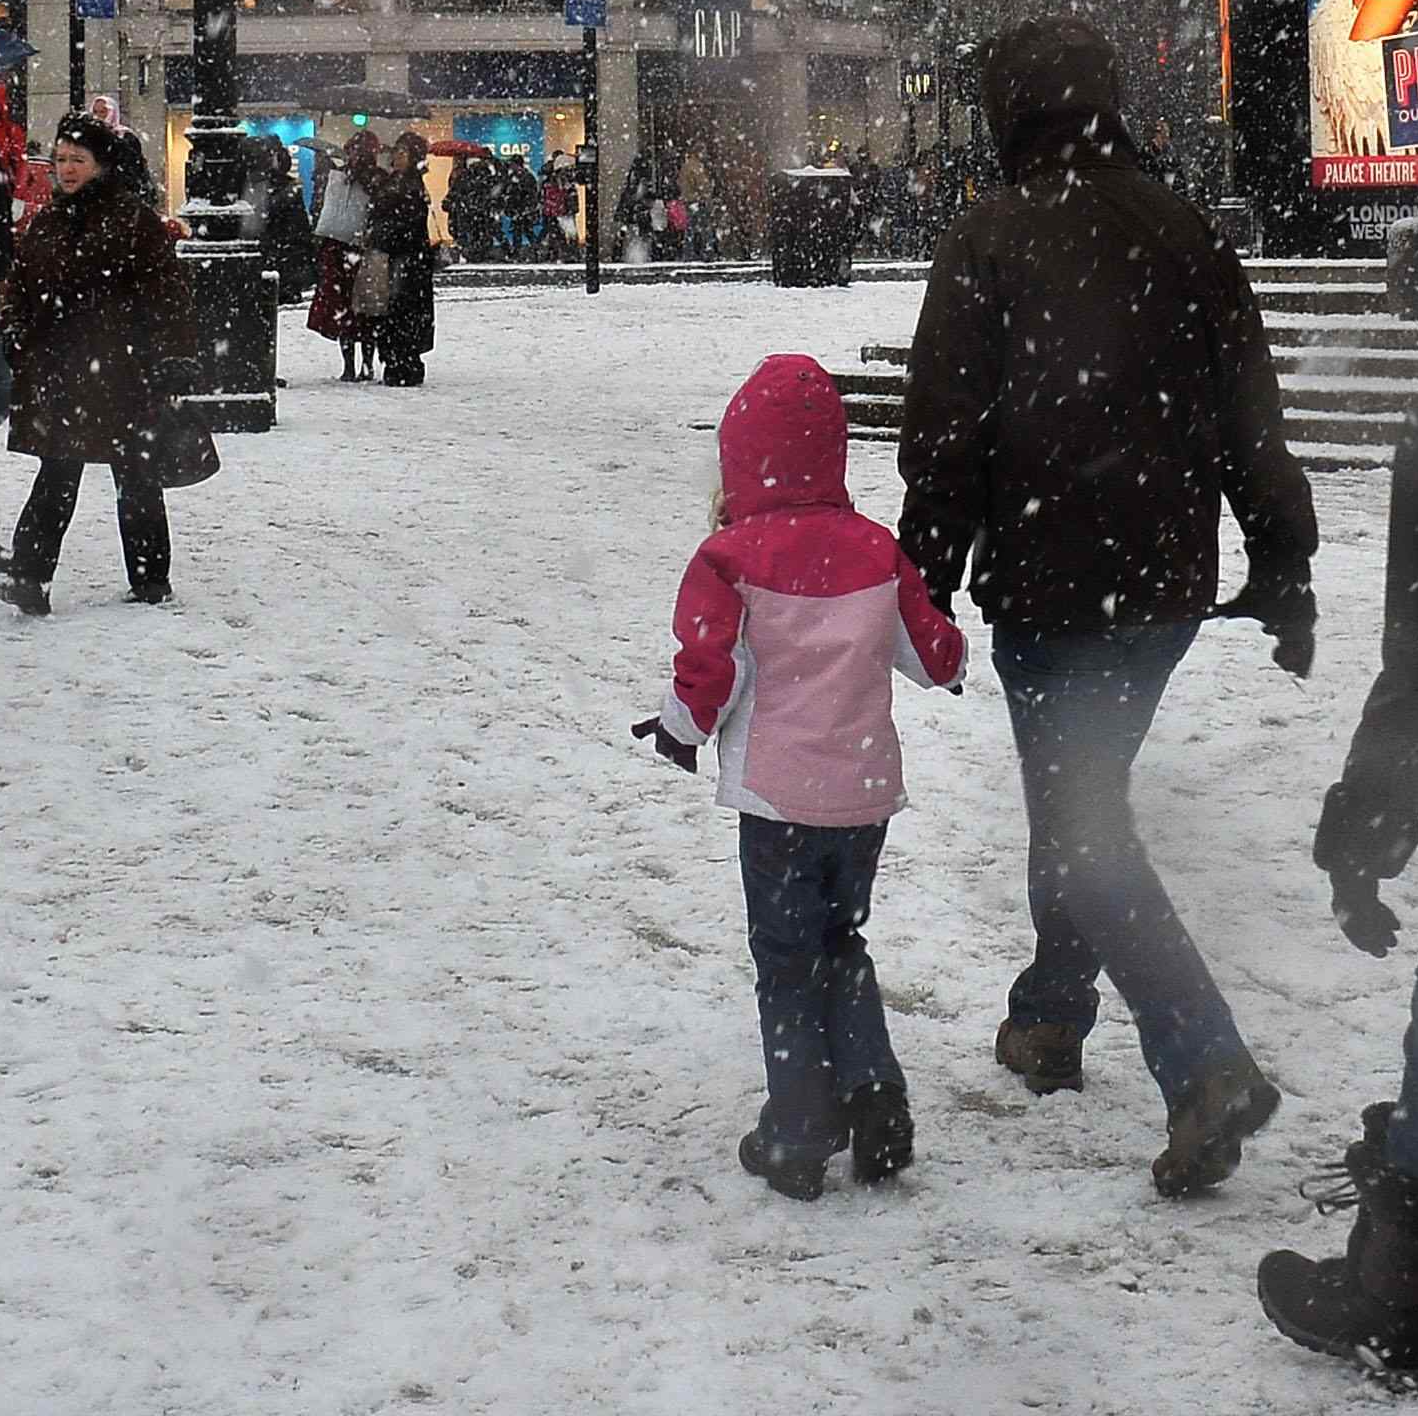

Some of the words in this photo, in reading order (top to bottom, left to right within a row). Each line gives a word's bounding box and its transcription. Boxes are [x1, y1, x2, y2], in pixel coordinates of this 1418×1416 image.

[694, 8, 741, 58] GAP
[905, 74, 931, 94] GAP
[1324, 162, 1366, 185] PALACE
[1369, 161, 1417, 183] THEATRE
